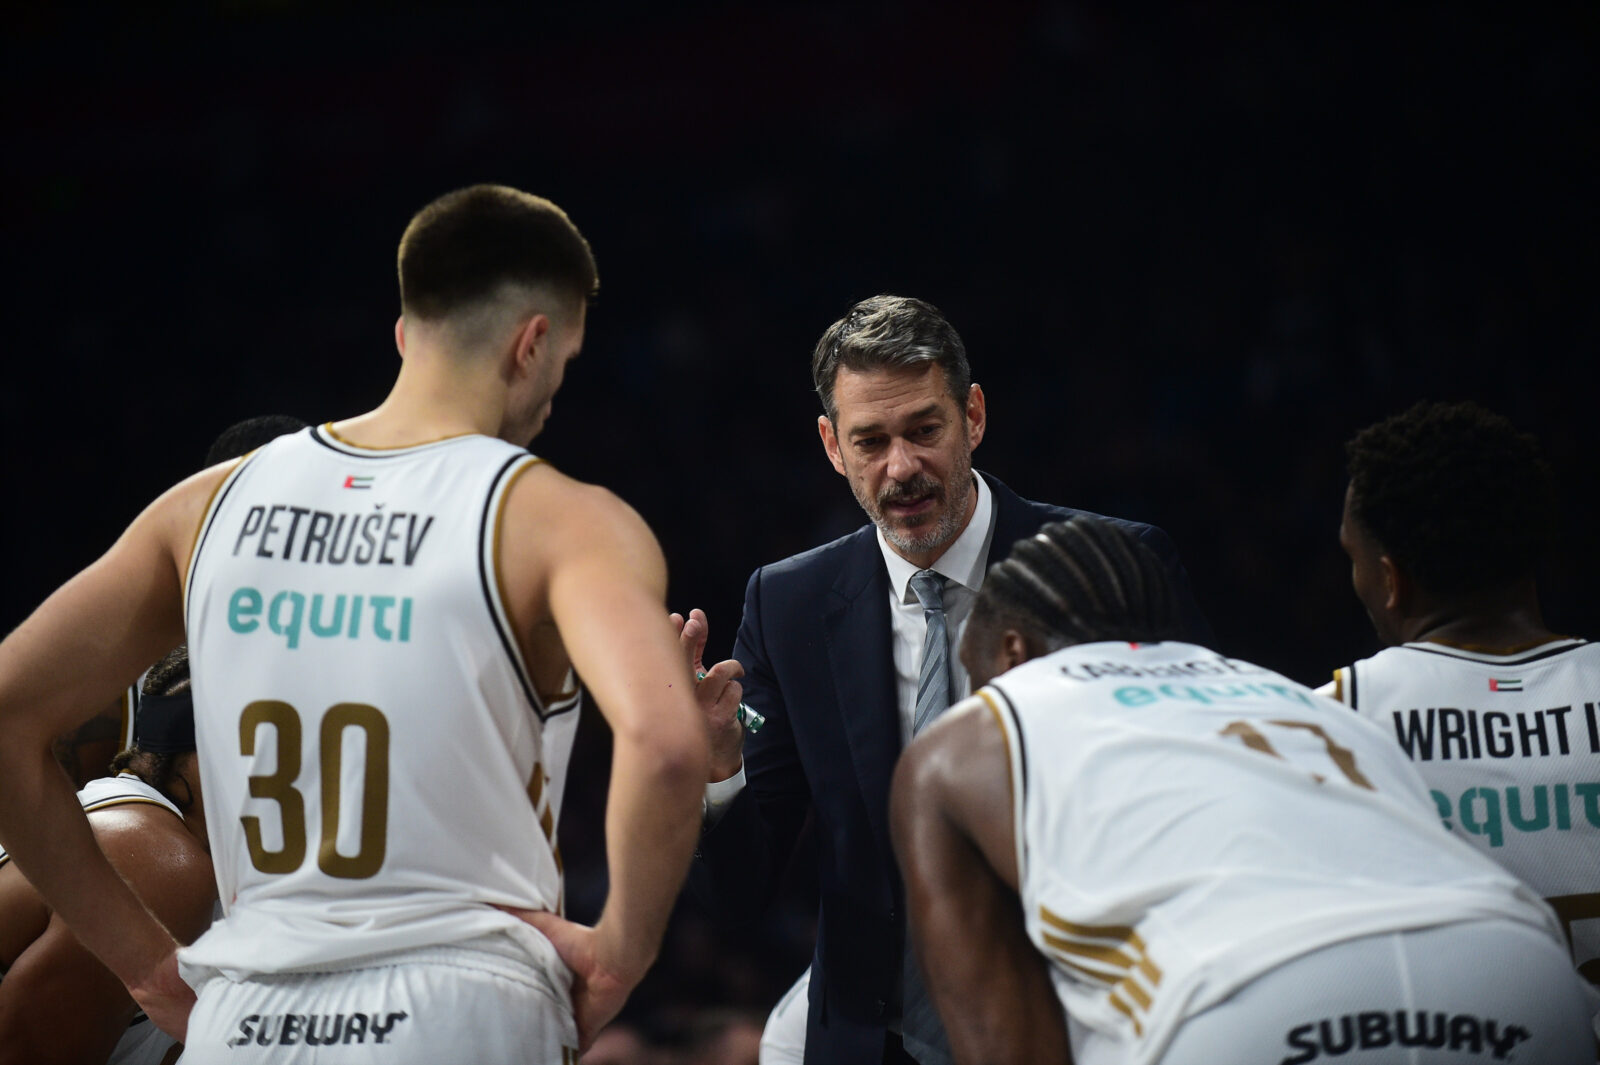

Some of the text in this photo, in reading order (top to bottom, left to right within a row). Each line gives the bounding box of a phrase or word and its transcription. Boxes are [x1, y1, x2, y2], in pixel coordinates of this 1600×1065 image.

[233, 503, 434, 566] PETRUŠEV
[228, 587, 413, 649] equiti
[1393, 702, 1600, 761] WRIGHT I
[239, 700, 390, 878] 30
[227, 1010, 409, 1049] SUBWAY
[1279, 1010, 1531, 1065] SUBWAY
